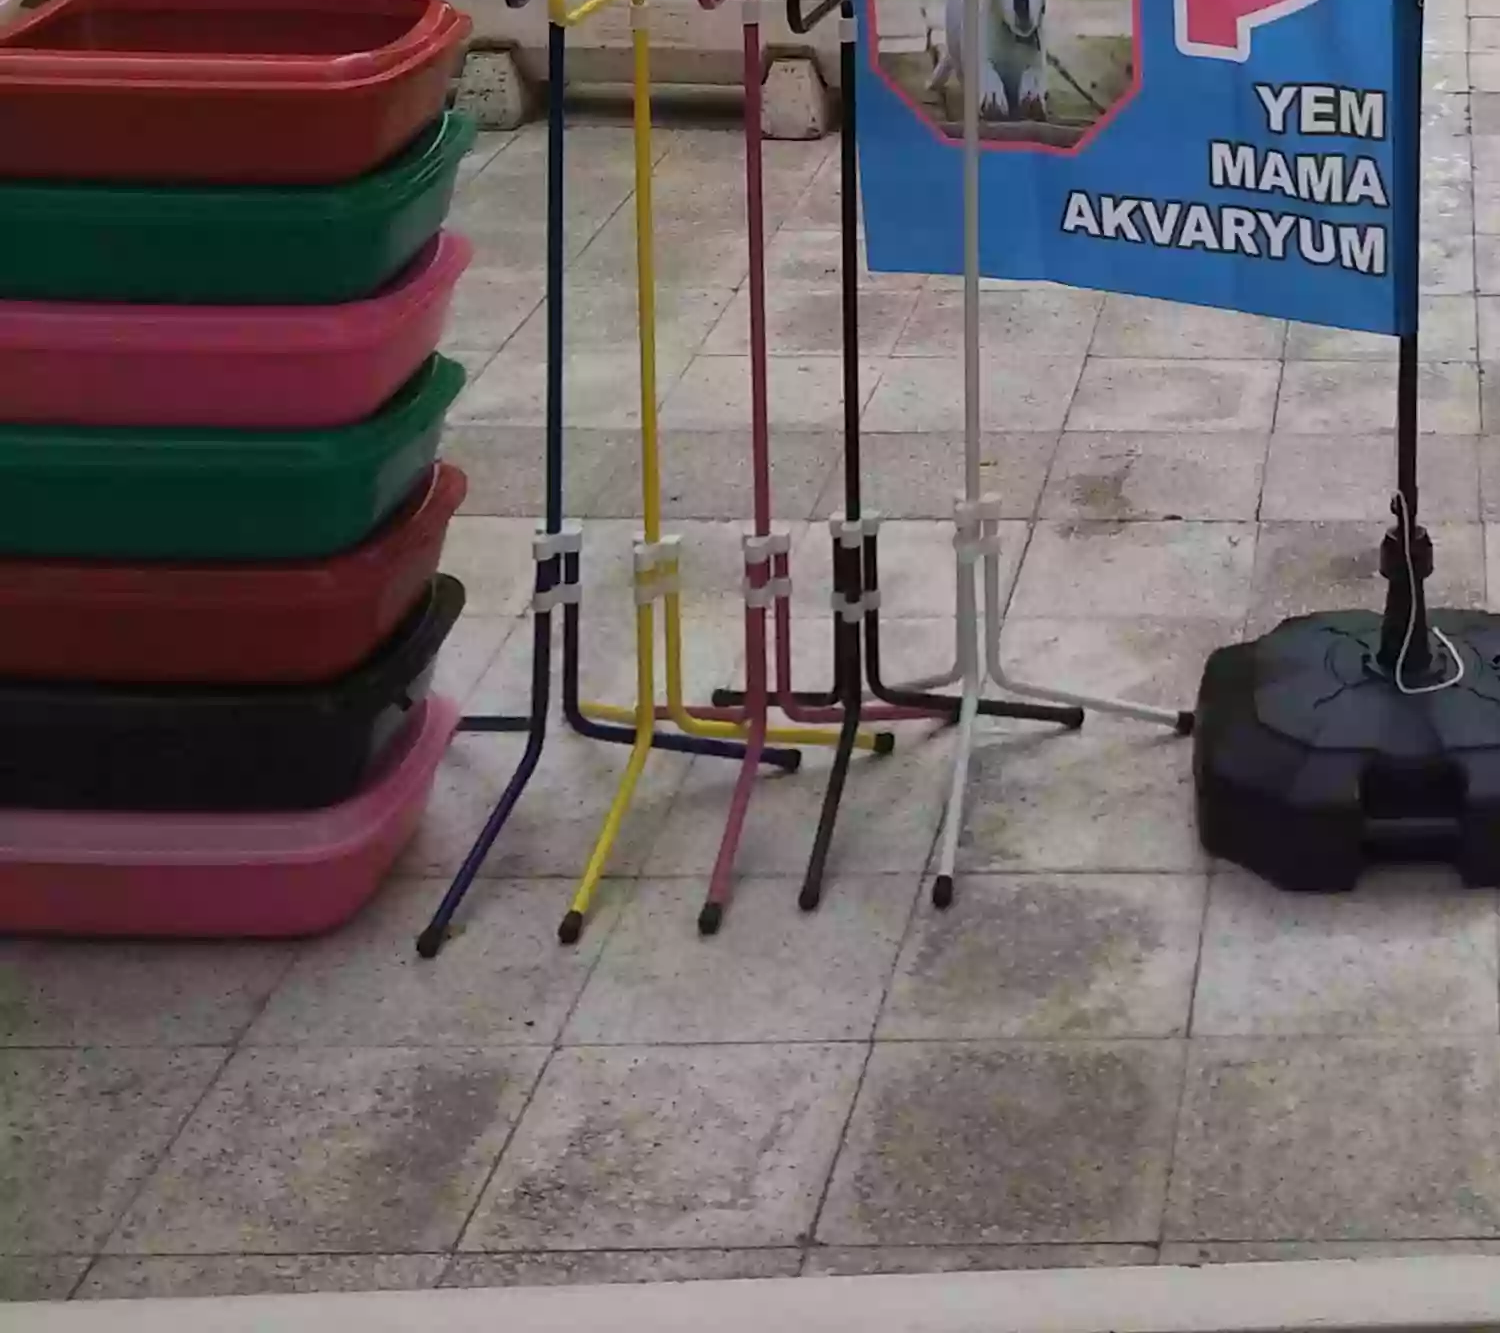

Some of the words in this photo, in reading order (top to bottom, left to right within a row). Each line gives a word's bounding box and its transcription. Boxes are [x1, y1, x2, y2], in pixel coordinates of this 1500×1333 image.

[1255, 83, 1386, 138] YEM
[1209, 141, 1389, 207] MAMA
[1061, 191, 1388, 276] AKVARYUM
